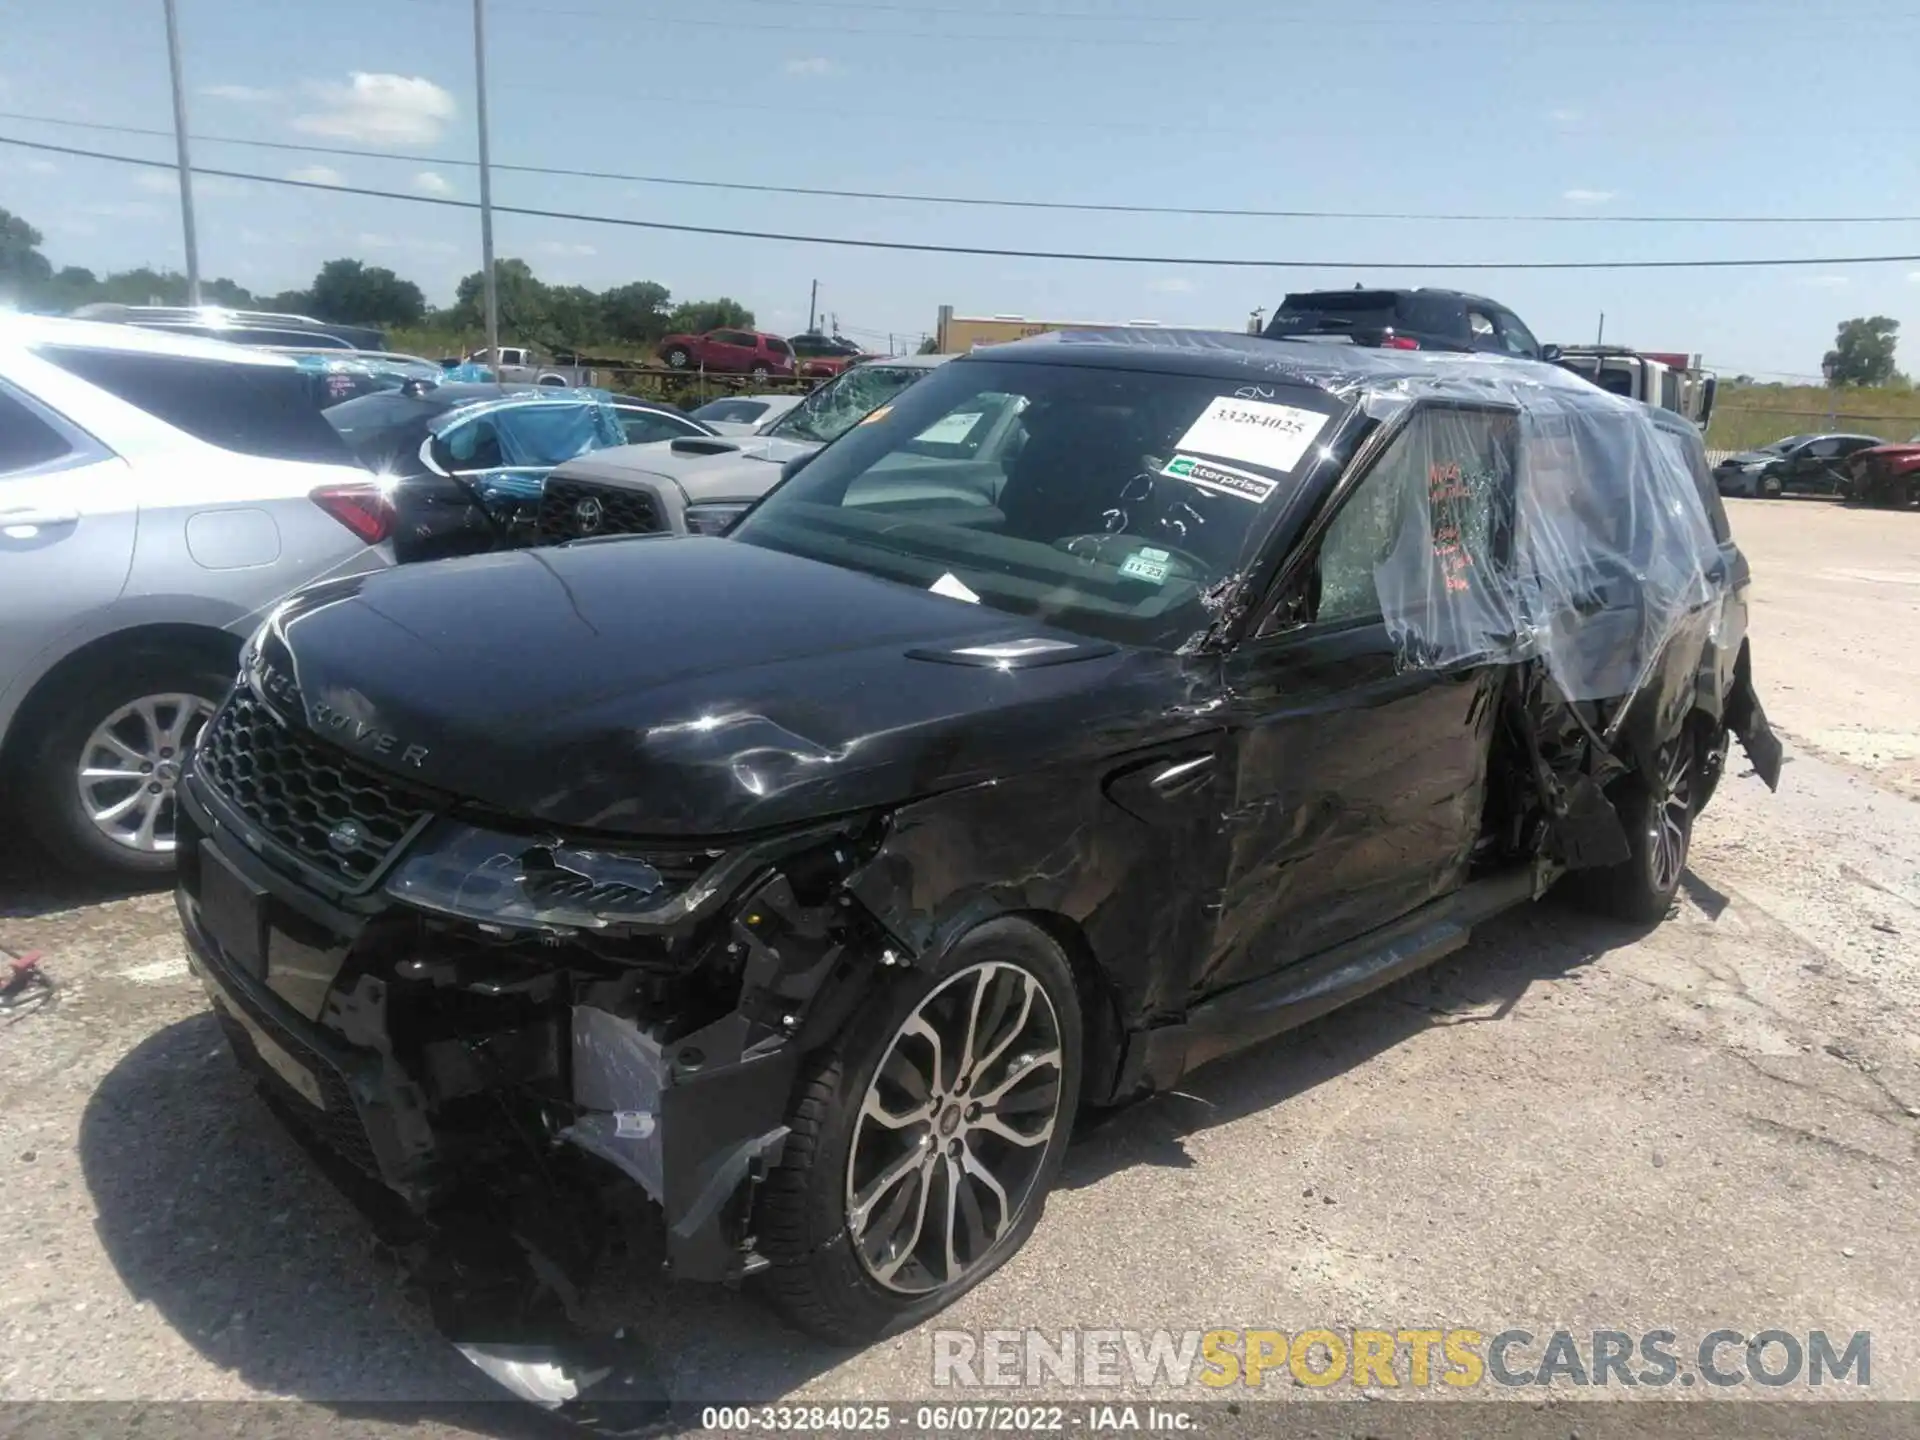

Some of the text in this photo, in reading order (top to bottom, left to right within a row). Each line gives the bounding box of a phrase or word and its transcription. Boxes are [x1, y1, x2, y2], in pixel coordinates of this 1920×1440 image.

[1212, 409, 1306, 434] 33284025
[1174, 461, 1267, 495] enterprise
[312, 700, 430, 768] ROVER
